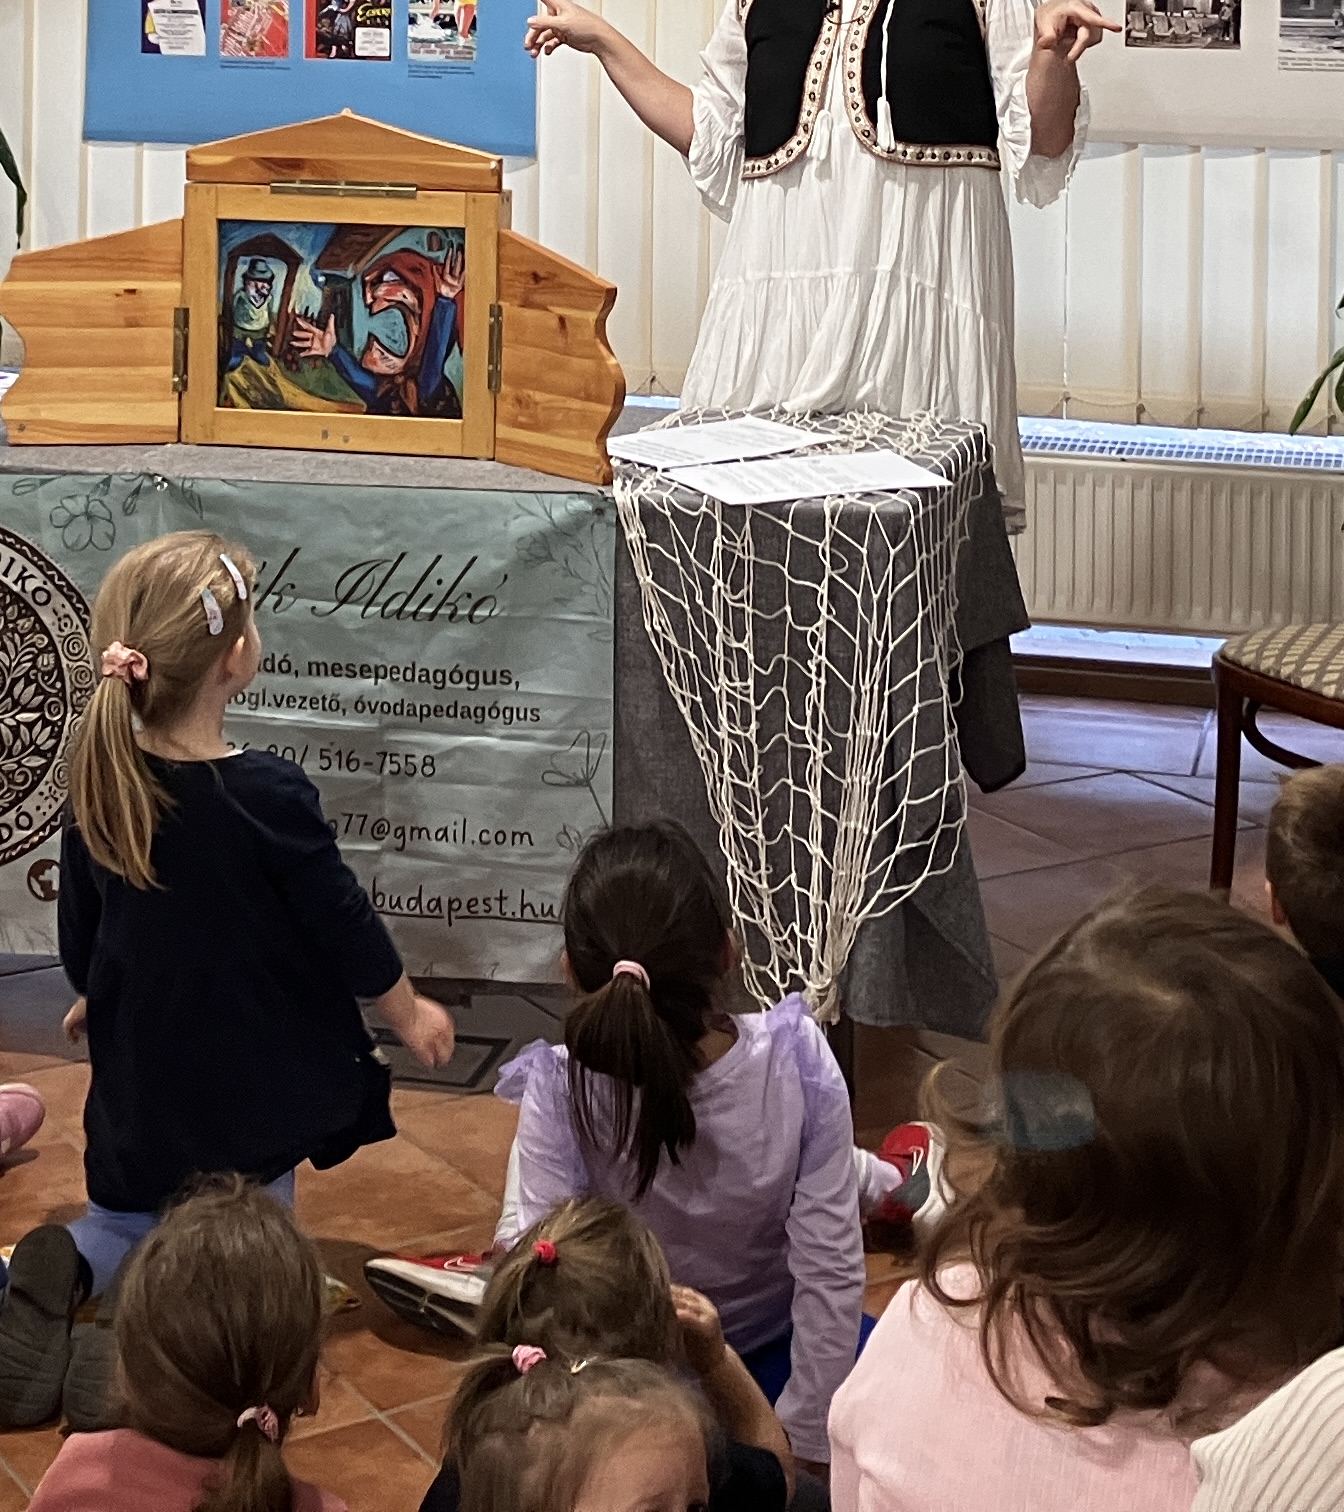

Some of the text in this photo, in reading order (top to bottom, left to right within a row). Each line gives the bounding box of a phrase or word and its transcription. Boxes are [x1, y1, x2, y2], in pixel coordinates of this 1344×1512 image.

[310, 552, 509, 625] Ildikó
[307, 658, 521, 691] mesepedagógus,
[353, 691, 541, 725] óvodapedagógus
[318, 747, 437, 778] 516-7558
[328, 813, 535, 852] 77@gmail.com
[371, 876, 558, 926] budapest.hu
